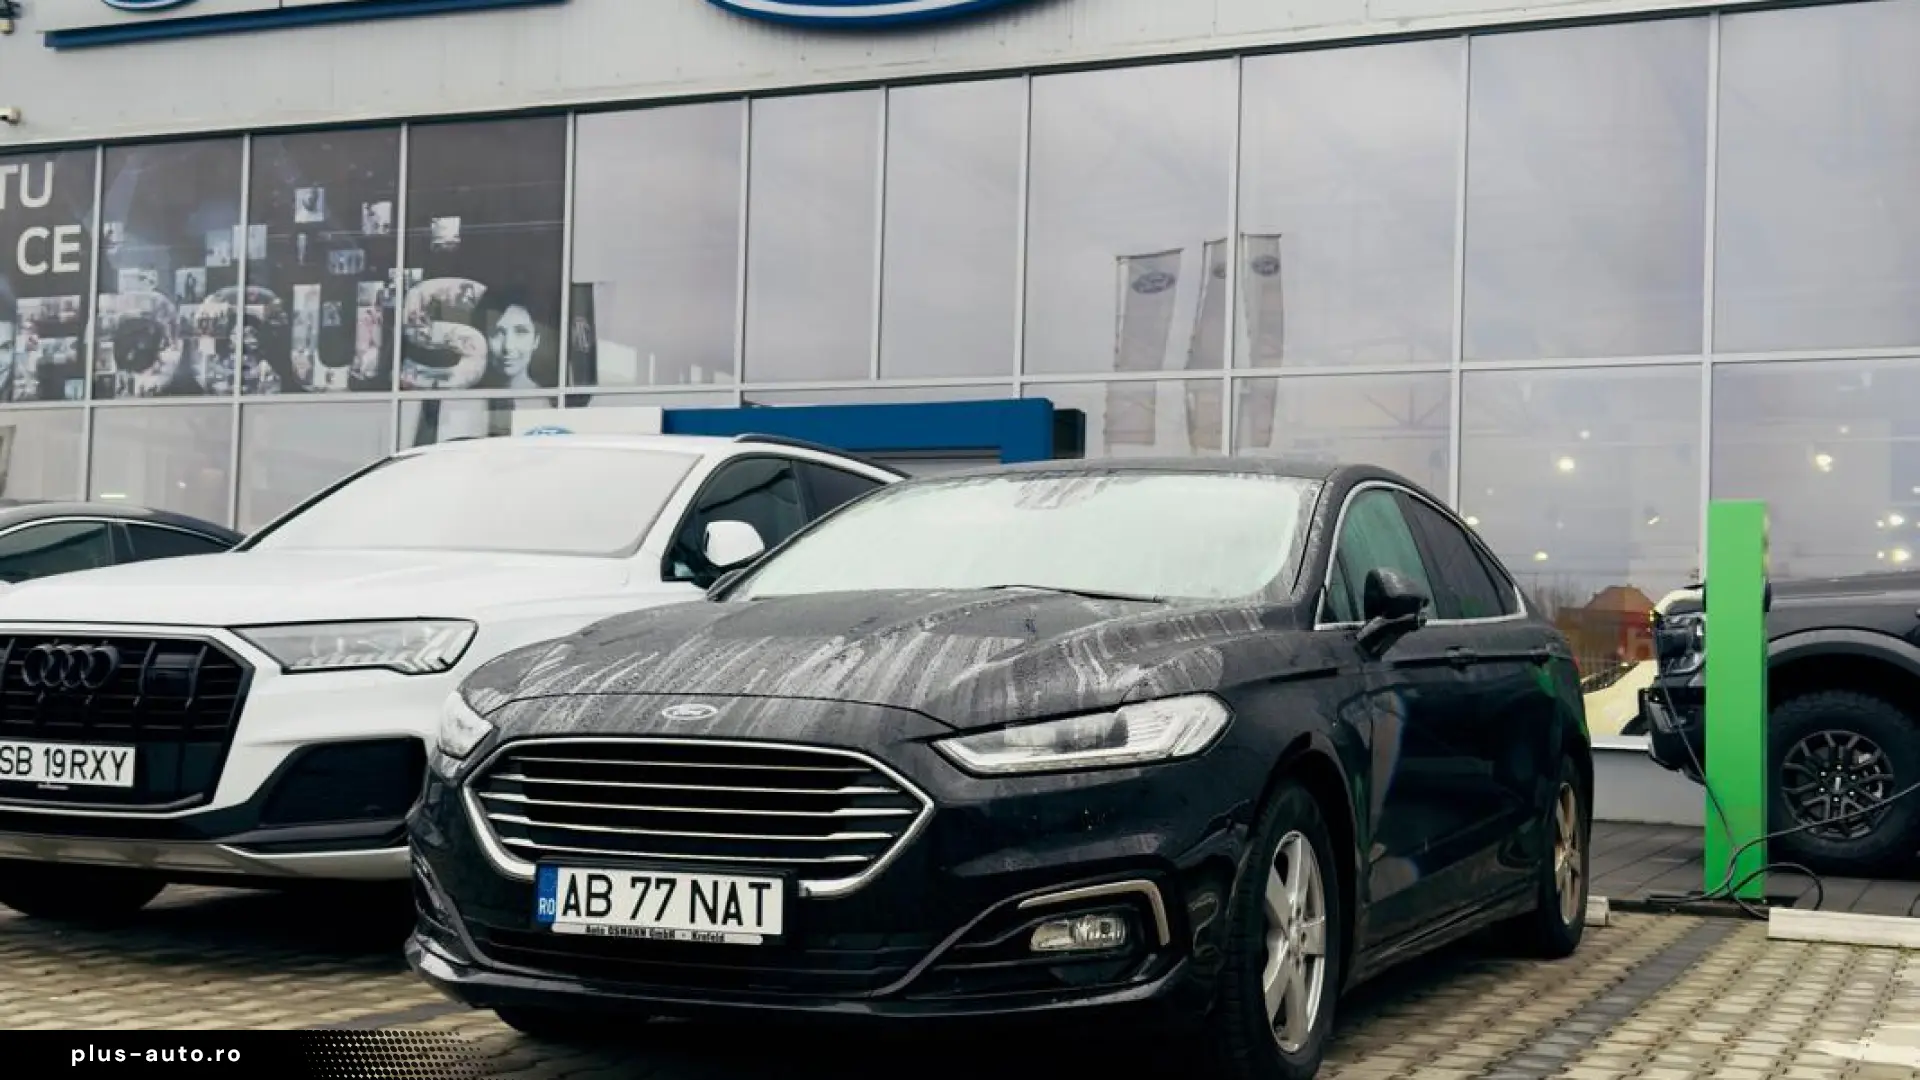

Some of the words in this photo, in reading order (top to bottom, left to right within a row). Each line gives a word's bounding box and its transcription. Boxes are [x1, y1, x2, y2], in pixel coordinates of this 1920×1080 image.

[16, 224, 82, 275] CE
[14, 277, 489, 402] FOCUS
[0, 745, 33, 776] SB
[539, 898, 555, 915] RO
[562, 873, 613, 918] AB
[630, 876, 677, 922] 77
[689, 879, 771, 927] NAT
